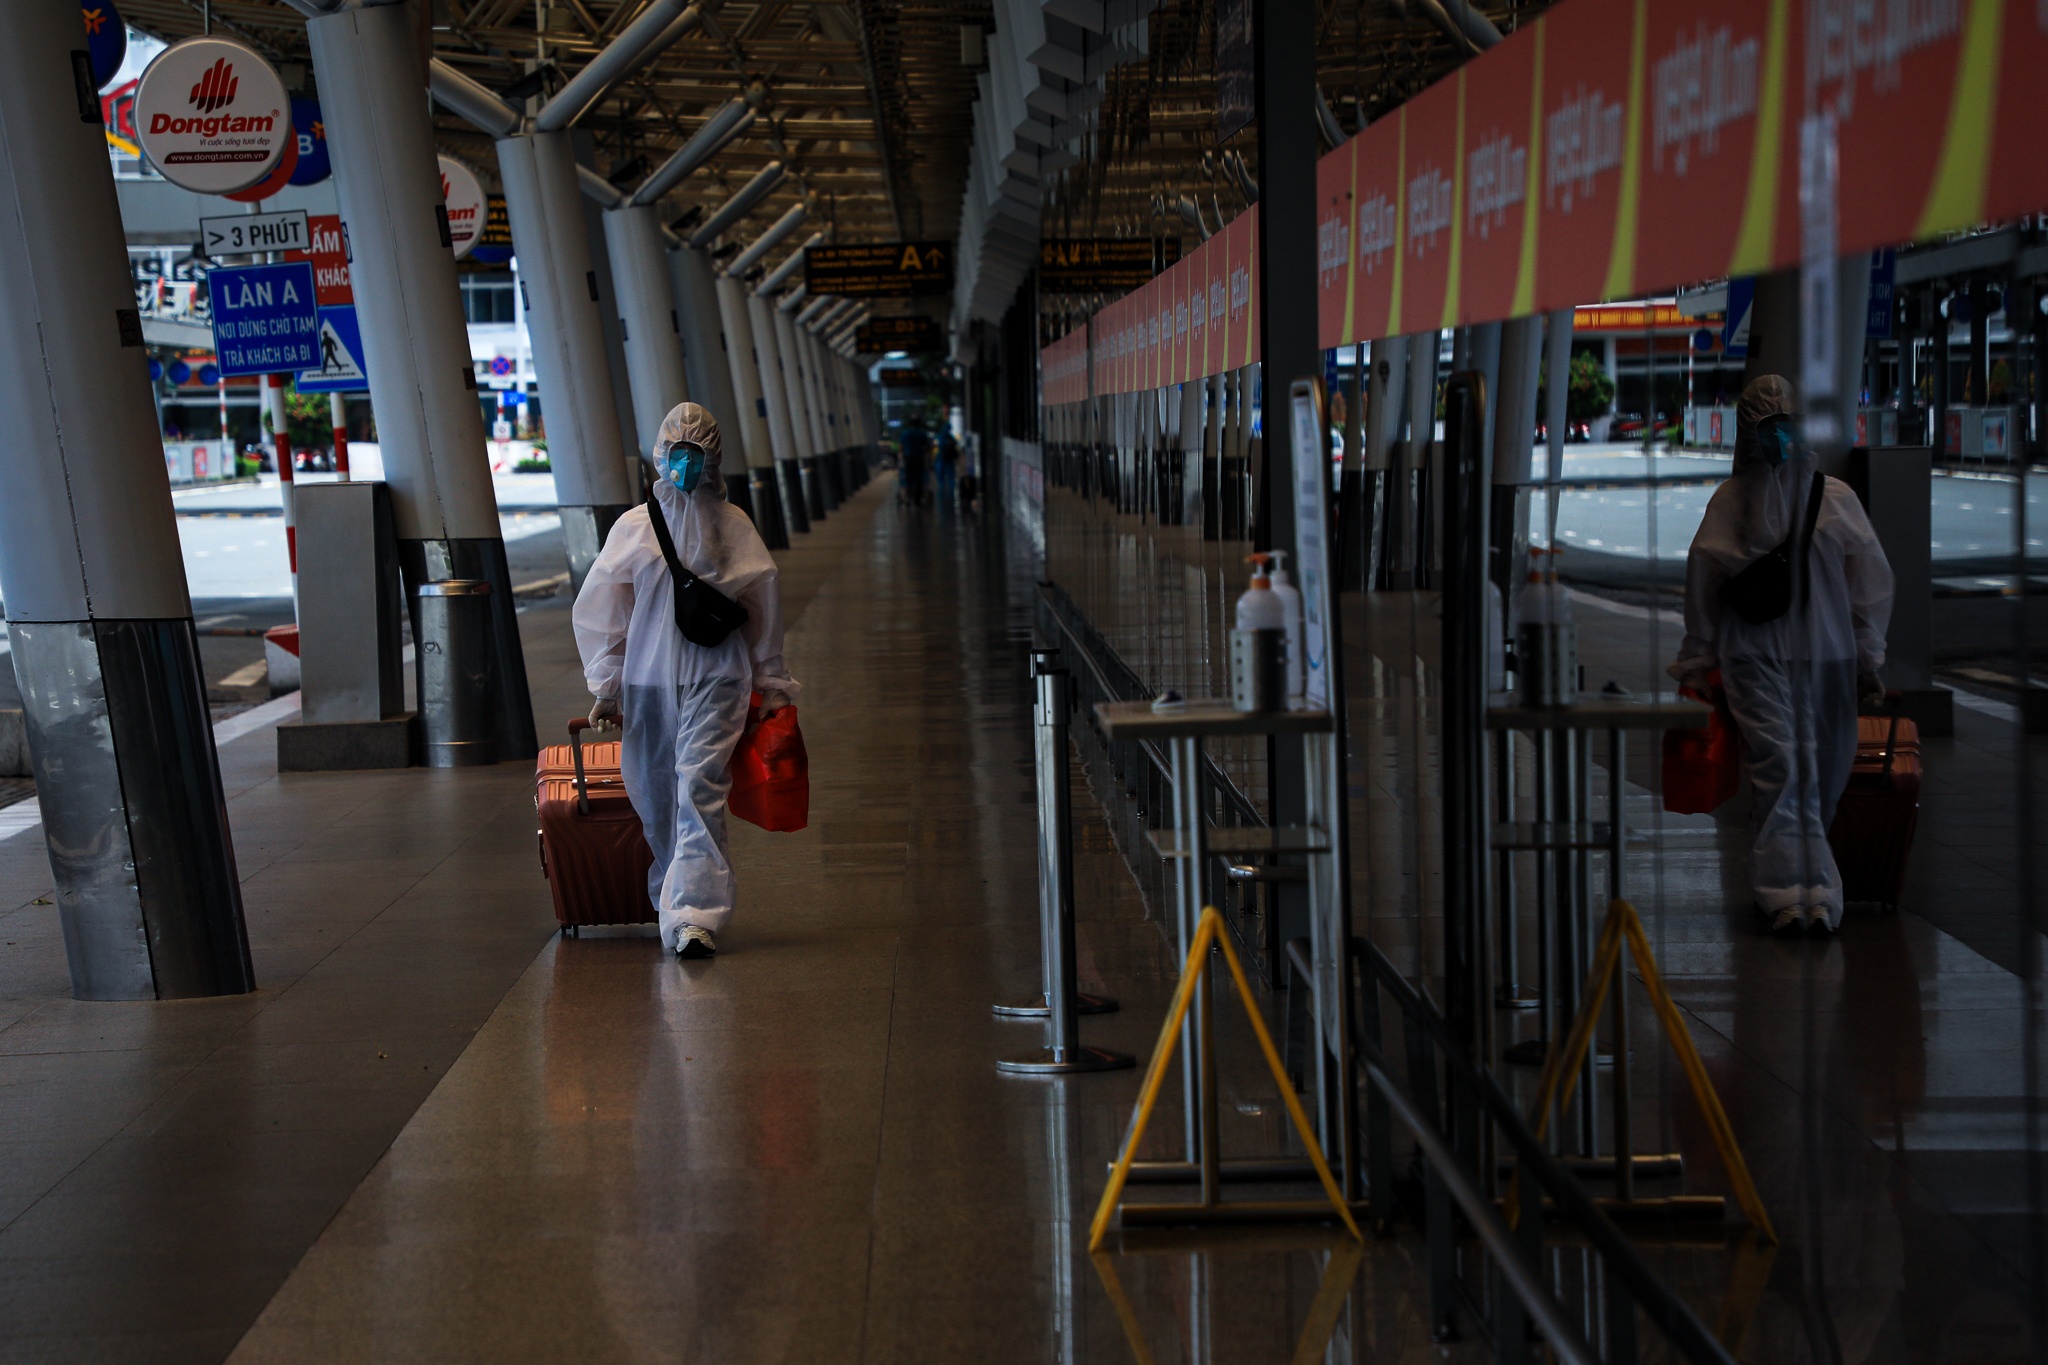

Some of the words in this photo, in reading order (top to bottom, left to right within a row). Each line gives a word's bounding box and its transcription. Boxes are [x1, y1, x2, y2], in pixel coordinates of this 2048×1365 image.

[149, 113, 273, 137] Dongtam
[170, 152, 265, 162] www.dongtam.com.vn
[231, 226, 243, 247] 3
[249, 217, 301, 246] PHÚT
[899, 244, 924, 271] A
[316, 262, 352, 288] KHÁC
[223, 275, 274, 309] LÀN
[282, 278, 300, 305] A
[217, 319, 236, 340] NƠI
[238, 315, 267, 338] DỪNG
[269, 312, 291, 336] CHỜ
[292, 315, 315, 337] TẠM
[224, 343, 245, 368] TRẢ
[246, 343, 281, 366] KHÁCH
[283, 344, 298, 363] GA
[299, 343, 311, 362] ĐI
